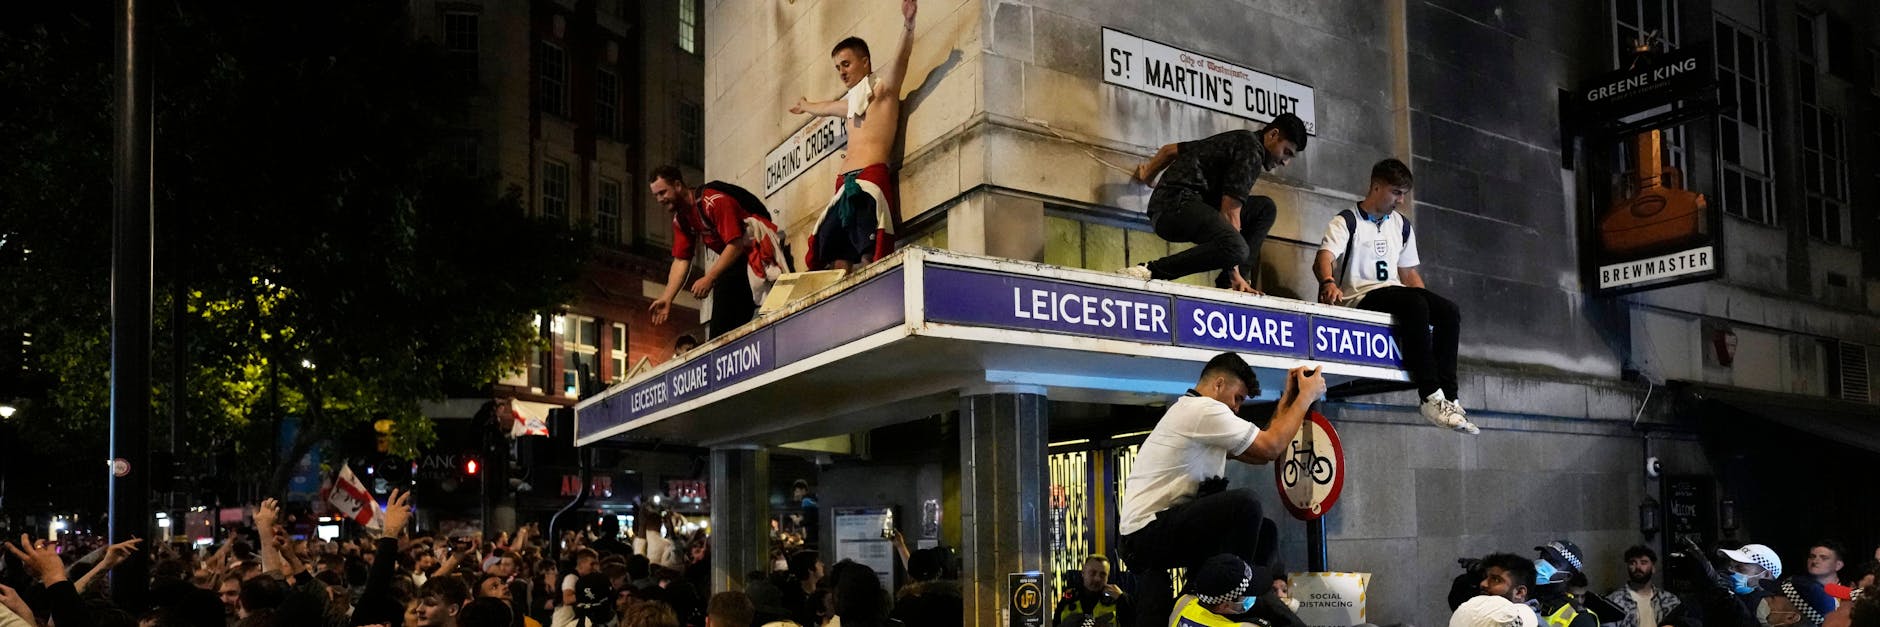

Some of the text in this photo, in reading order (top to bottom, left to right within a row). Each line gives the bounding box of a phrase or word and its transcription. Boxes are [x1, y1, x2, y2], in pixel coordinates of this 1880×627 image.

[1145, 57, 1233, 106] MARTIN'S
[1245, 84, 1299, 116] COURT
[1587, 72, 1648, 102] GREENE
[1653, 58, 1696, 81] KING
[766, 145, 801, 190] CHARING
[805, 120, 835, 162] CROSS
[1376, 260, 1388, 281] 6
[1603, 252, 1707, 283] BREWMASTER
[1014, 287, 1403, 361] LEICESTER SQUARE STATION
[631, 341, 760, 413] LEICESTER SQUARE STATION
